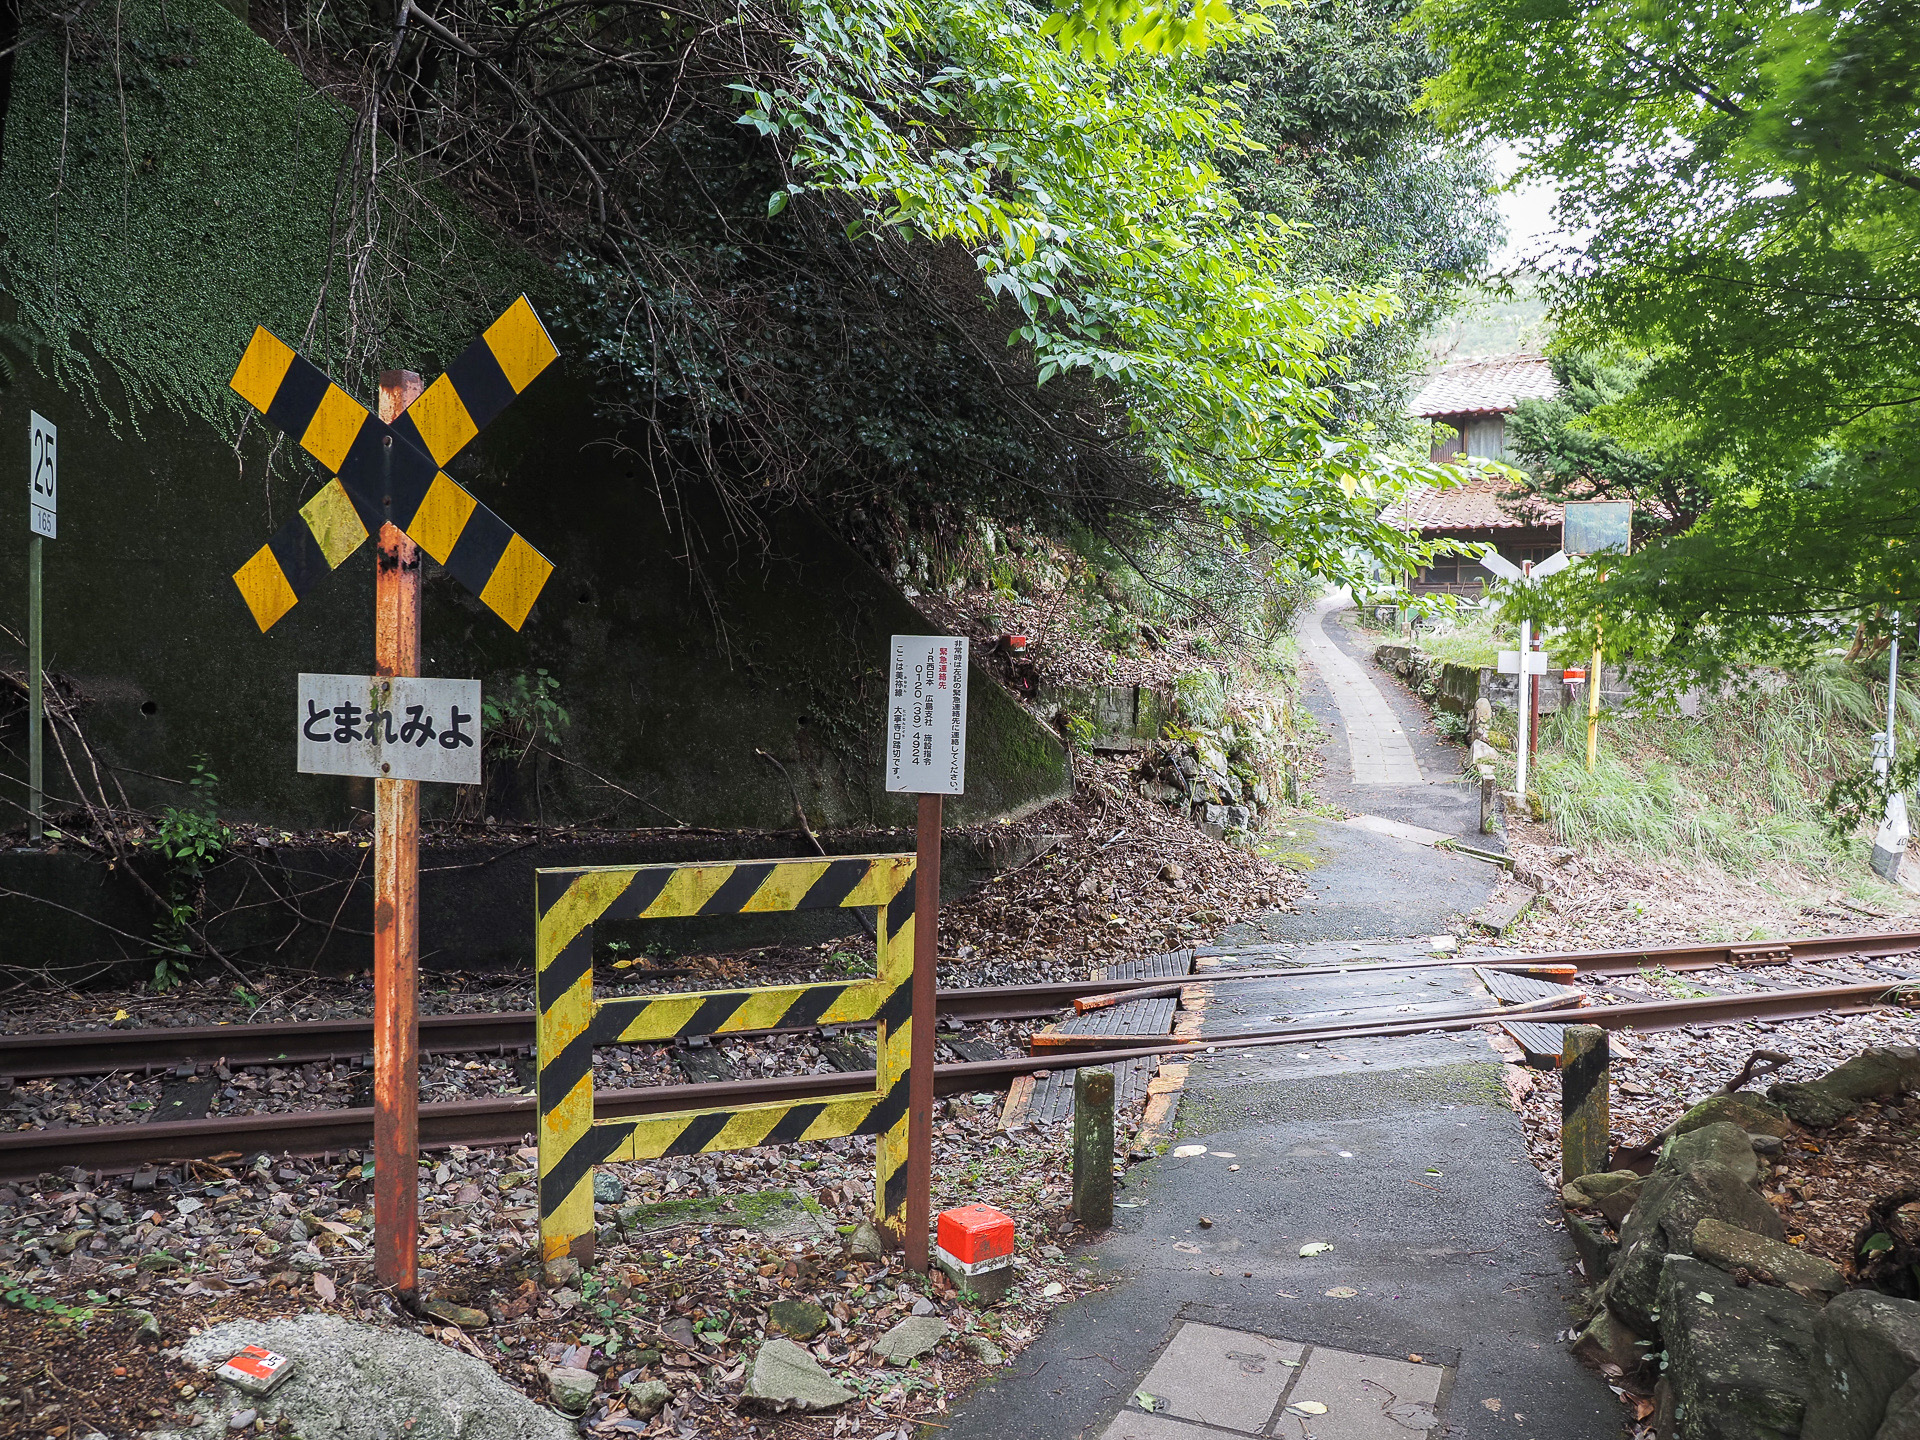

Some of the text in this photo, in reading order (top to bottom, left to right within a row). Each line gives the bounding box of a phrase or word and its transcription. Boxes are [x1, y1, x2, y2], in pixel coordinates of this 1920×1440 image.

[34, 428, 54, 498] 25
[37, 510, 52, 532] 165
[938, 647, 948, 690] 緊急連絡先
[303, 698, 474, 750] とまれみよ
[923, 648, 934, 766] JR西日本 広島支社 施設指令
[949, 639, 963, 791] 非常時は左記の緊急連絡先に連絡してください。
